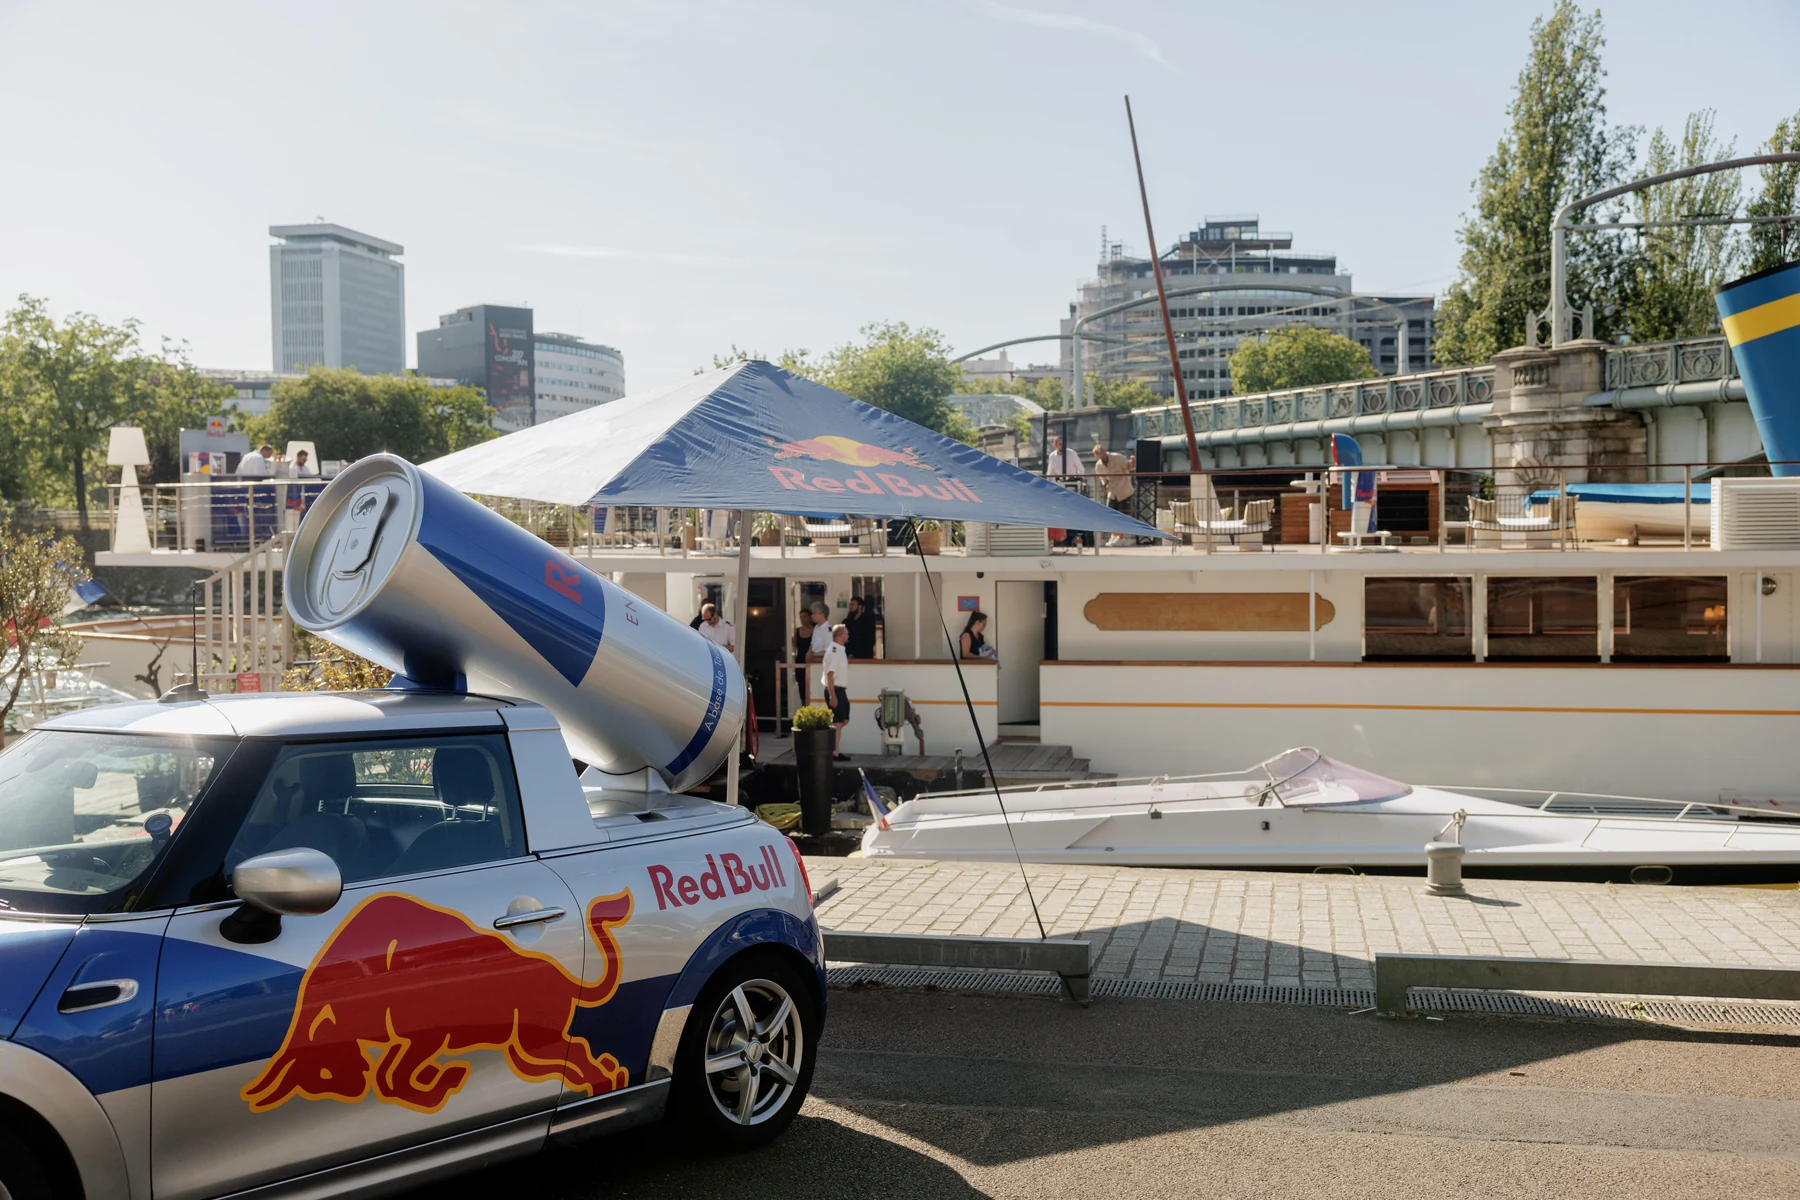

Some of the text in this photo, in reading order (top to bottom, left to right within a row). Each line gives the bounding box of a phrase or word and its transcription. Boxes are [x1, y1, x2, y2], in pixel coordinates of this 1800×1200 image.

[768, 466, 983, 503] Red Bull
[715, 670, 724, 686] de
[708, 688, 724, 718] base
[704, 721, 715, 731] A
[647, 844, 787, 911] Red Bull
